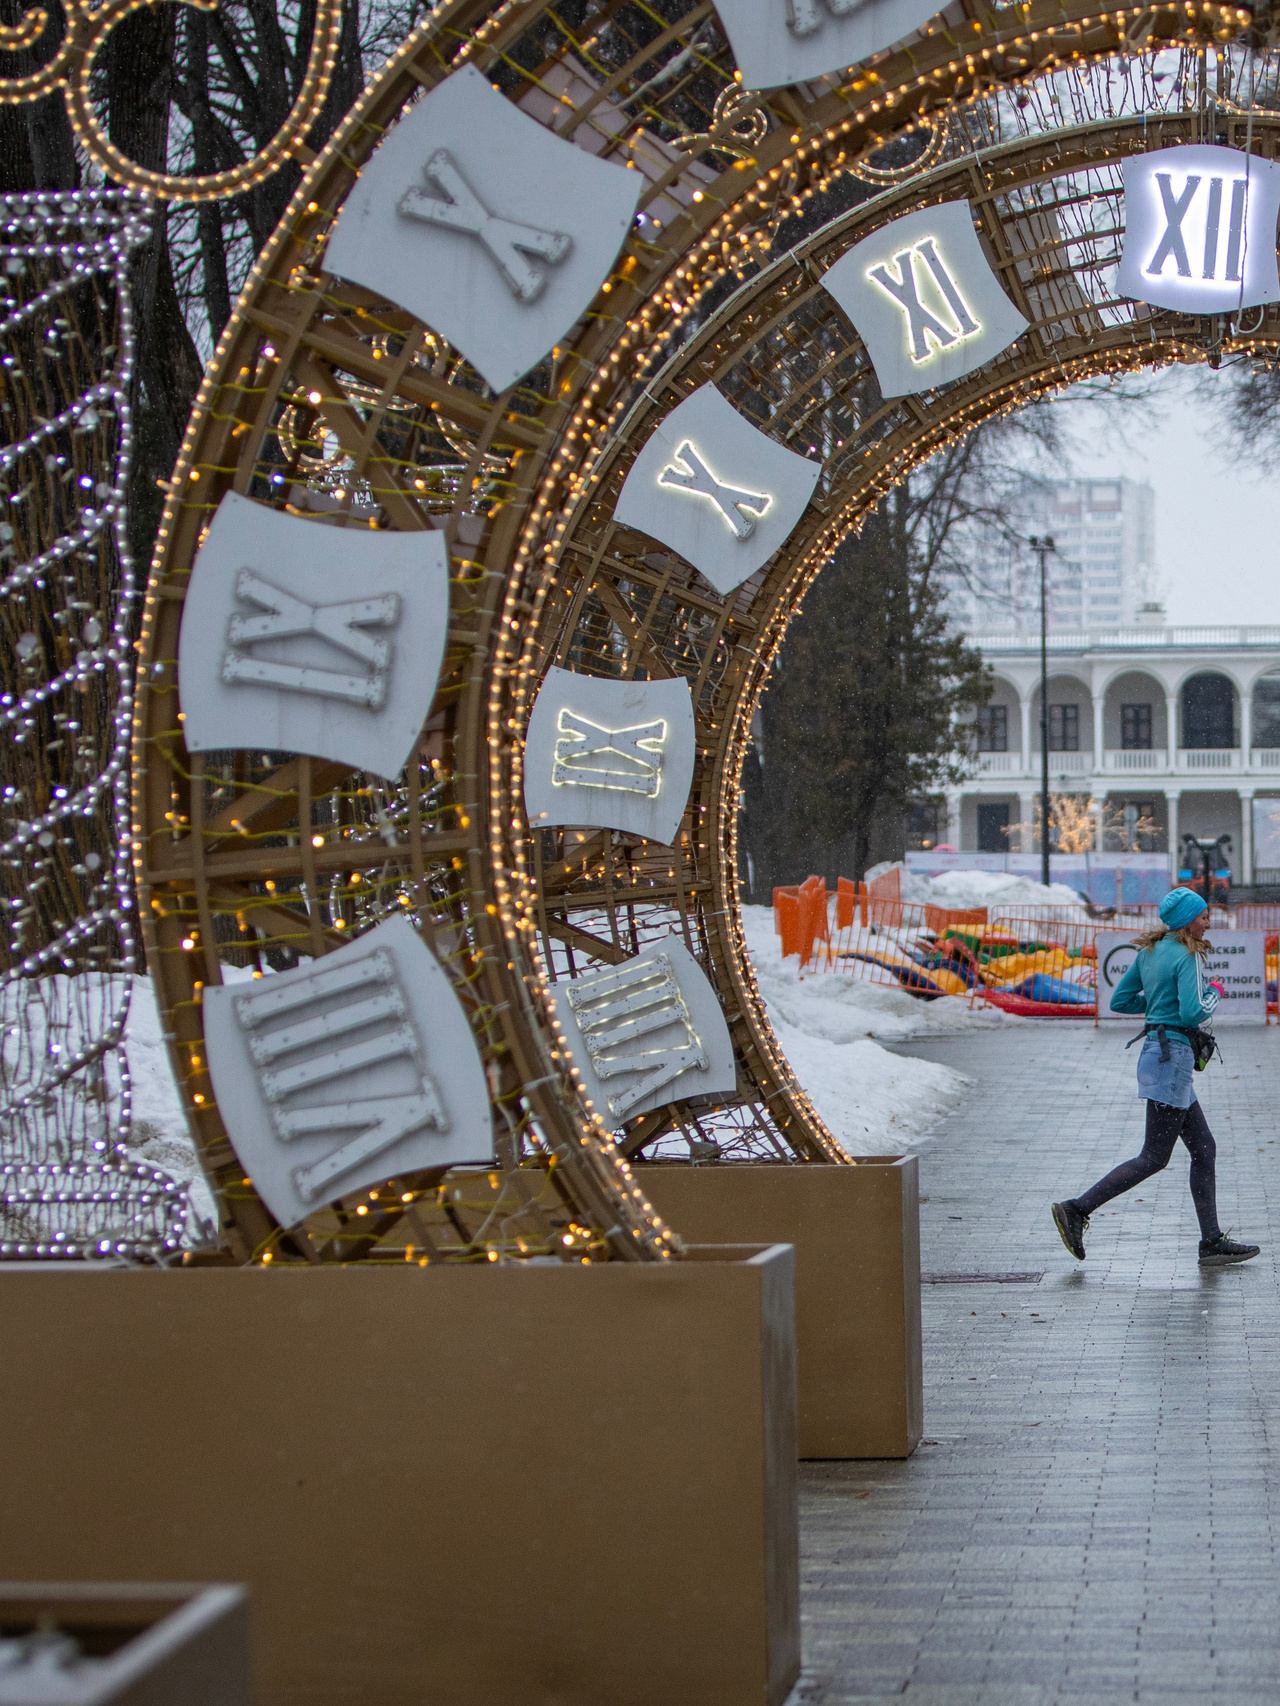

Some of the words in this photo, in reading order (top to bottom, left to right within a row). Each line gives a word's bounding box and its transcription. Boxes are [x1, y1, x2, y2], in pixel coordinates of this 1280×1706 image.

[395, 147, 574, 305] X
[1144, 171, 1248, 282] XII
[866, 236, 982, 364] XI
[656, 438, 773, 541] X
[221, 567, 402, 711] IX
[551, 707, 668, 799] IX
[233, 946, 450, 1203] VIII
[565, 952, 710, 1118] VIII
